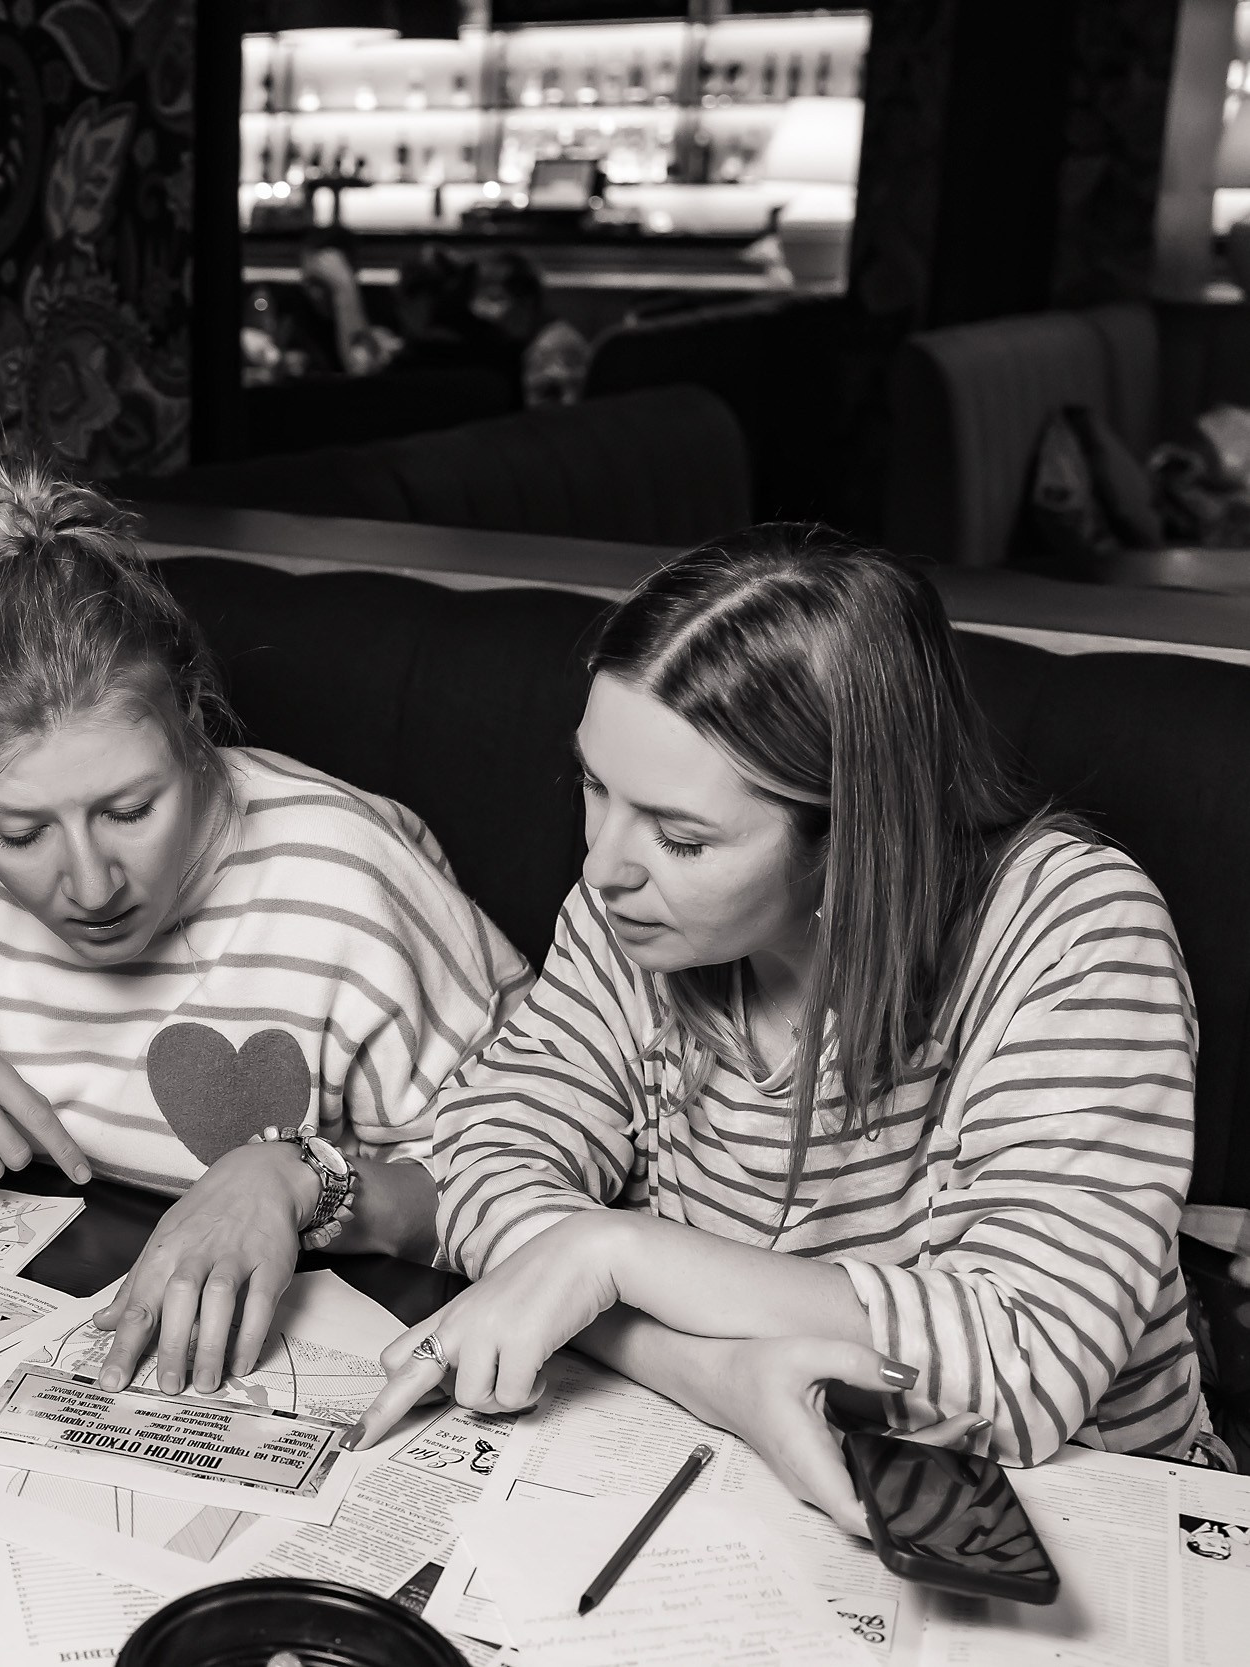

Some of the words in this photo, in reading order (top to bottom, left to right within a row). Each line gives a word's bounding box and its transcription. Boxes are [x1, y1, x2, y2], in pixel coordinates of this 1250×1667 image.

[96, 1421, 131, 1435] только
[435, 1429, 467, 1442] ДА-82
[59, 1428, 141, 1453] ОТХОДОВ
[133, 1428, 184, 1446] разрешён
[422, 1438, 448, 1449] КРАСОТЫ
[143, 1444, 222, 1468] ПОЛИГОН
[186, 1439, 249, 1457] территорию
[254, 1451, 268, 1460] на
[270, 1452, 305, 1469] Заезд
[406, 1447, 464, 1468] Ева
[356, 1493, 405, 1513] ЧИТАТЕЛЕЙ
[408, 1510, 444, 1527] ПИСЬМА
[58, 1648, 116, 1662] ЕВНЯ
